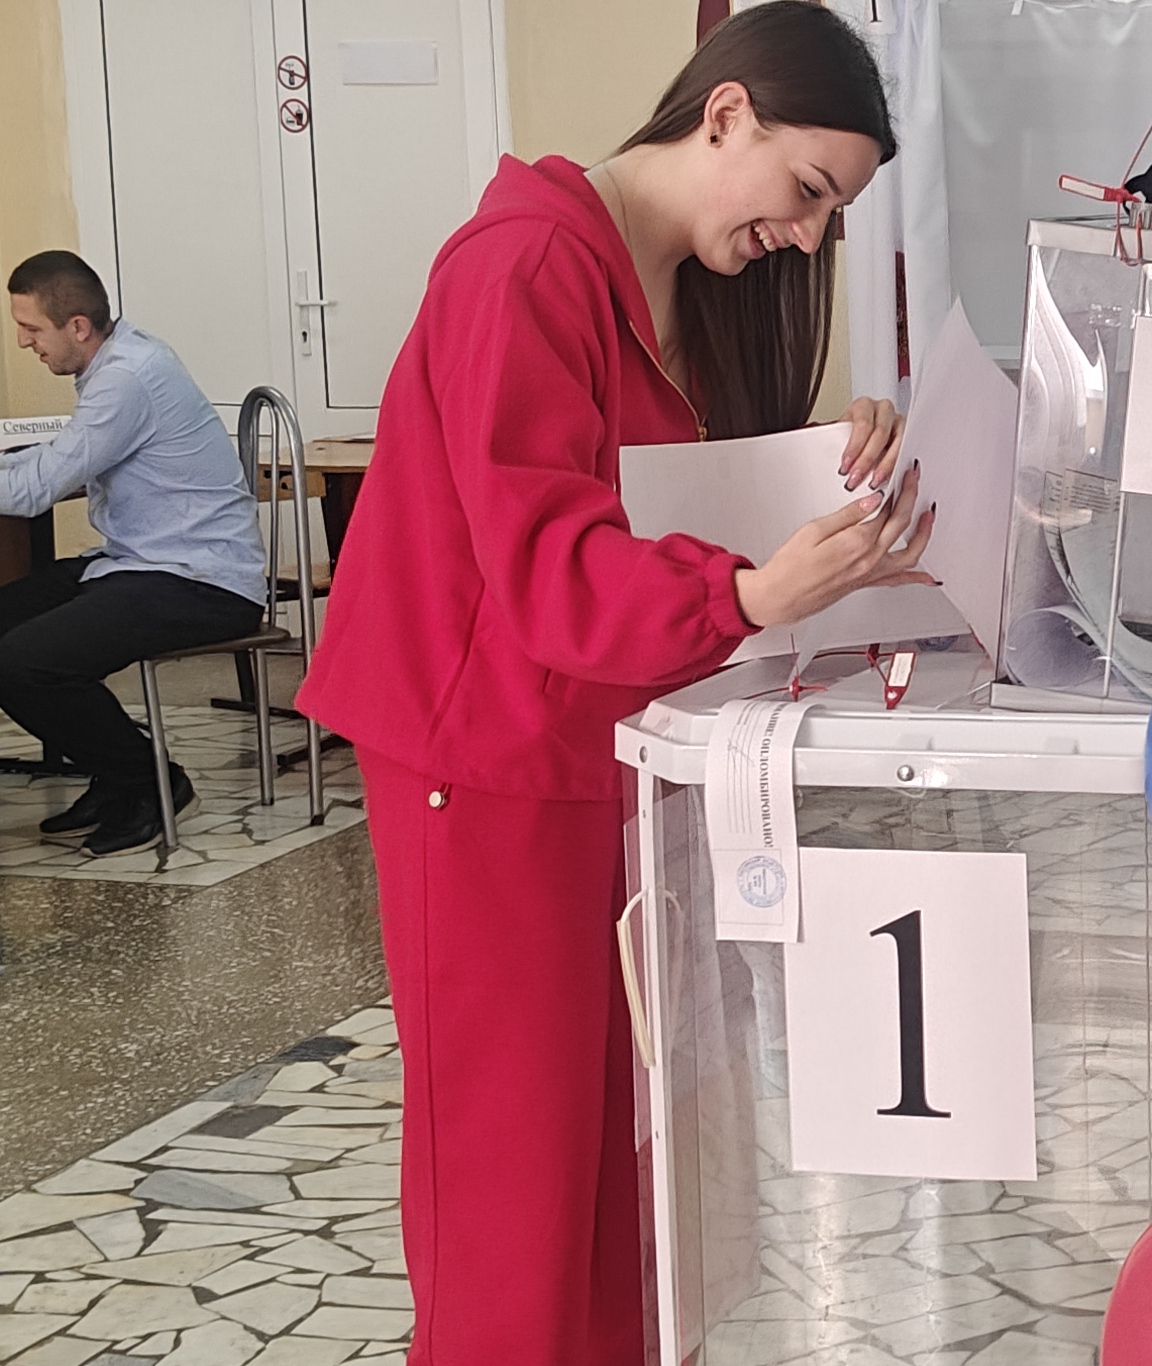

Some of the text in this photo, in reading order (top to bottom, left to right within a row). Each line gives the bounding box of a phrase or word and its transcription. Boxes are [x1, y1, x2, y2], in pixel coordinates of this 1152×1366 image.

[3, 418, 63, 433] Северный
[759, 738, 774, 848] ОПЛОМБИРОВАНО!
[869, 909, 952, 1118] 1
